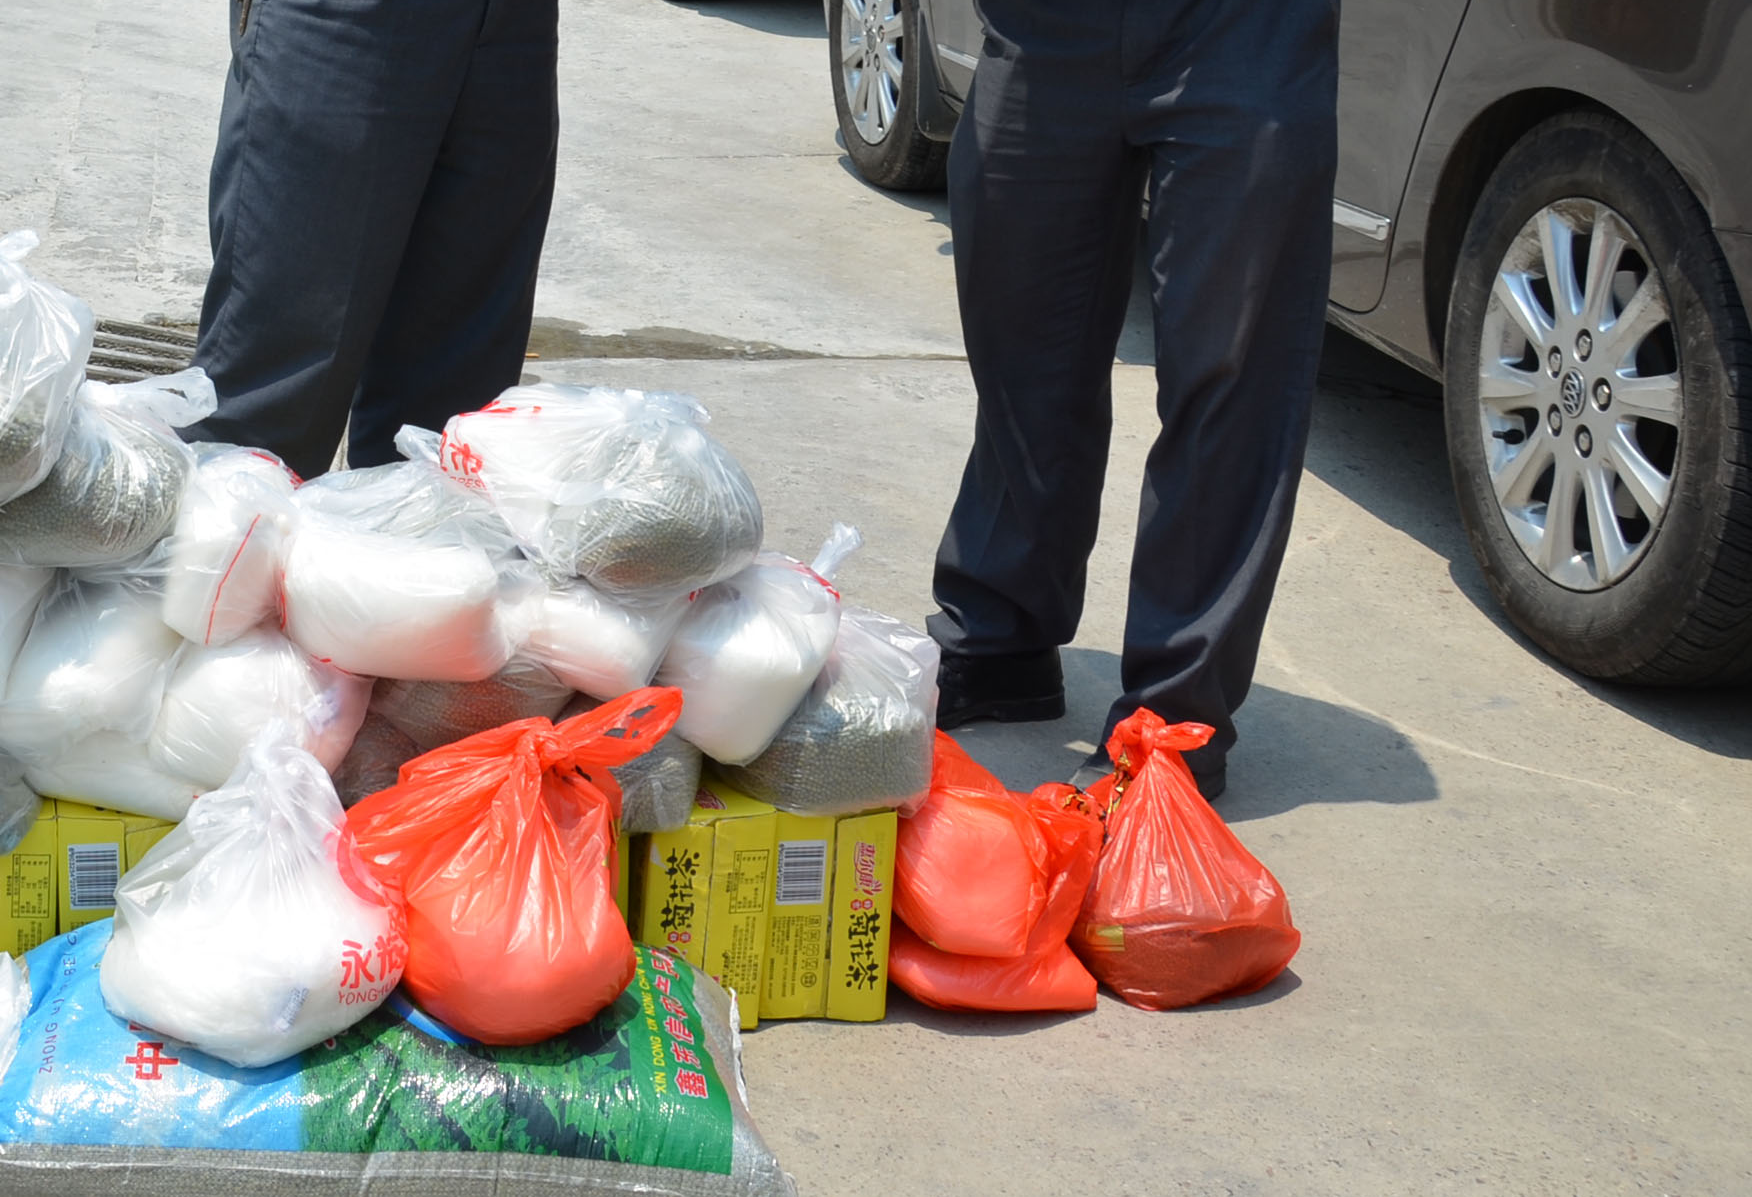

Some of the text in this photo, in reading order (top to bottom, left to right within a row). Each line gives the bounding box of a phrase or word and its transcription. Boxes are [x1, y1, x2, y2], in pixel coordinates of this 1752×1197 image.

[659, 847, 701, 934] 菊花茶
[845, 909, 881, 991] 菊花茶
[37, 1021, 59, 1075] ZHONG
[649, 1035, 666, 1067] DONG
[654, 1070, 668, 1094] XIN
